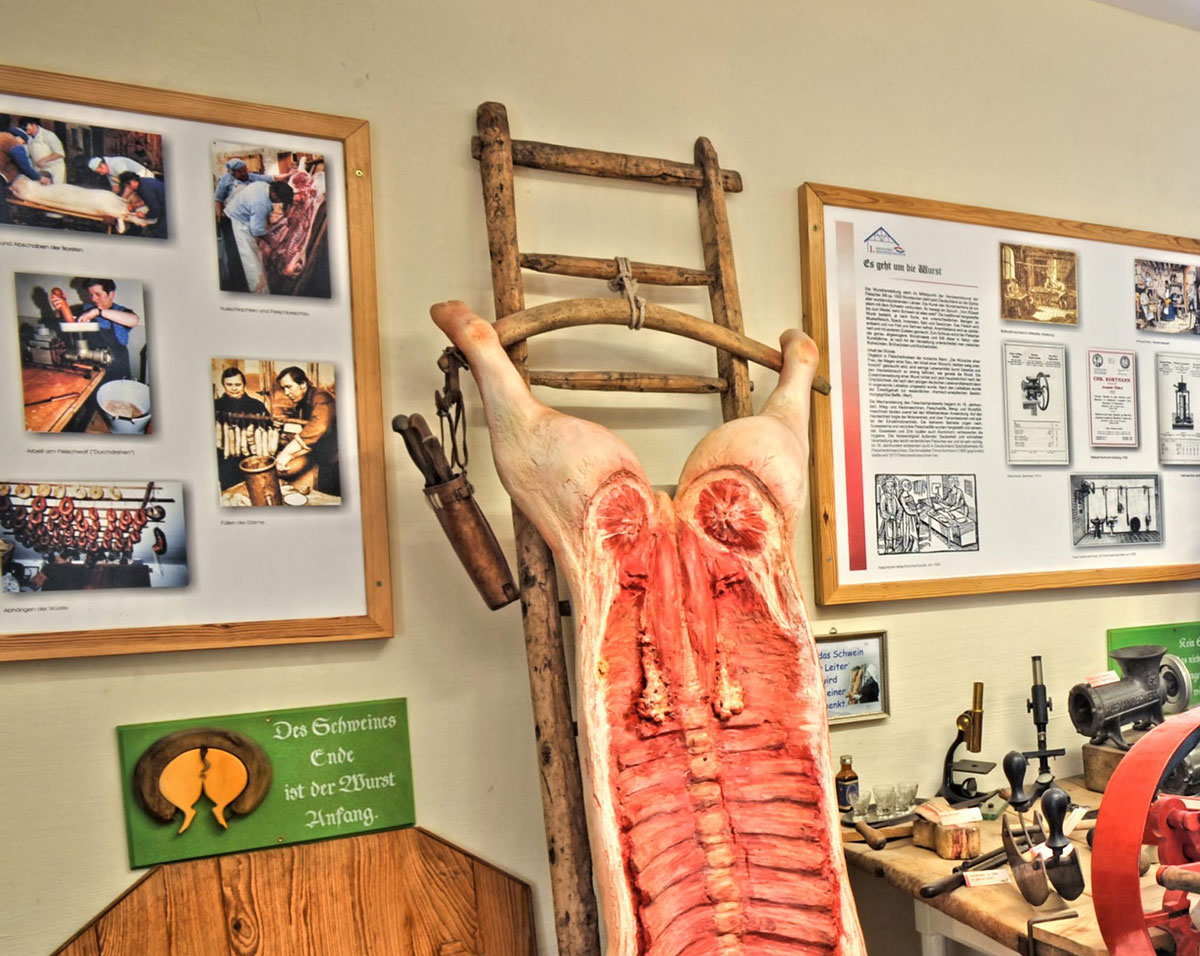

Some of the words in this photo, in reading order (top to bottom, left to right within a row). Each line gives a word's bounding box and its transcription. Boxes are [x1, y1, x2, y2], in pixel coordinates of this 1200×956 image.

[863, 259, 875, 268] Es
[876, 261, 892, 271] geht
[893, 263, 905, 272] um
[906, 263, 916, 273] die
[918, 264, 942, 275] Wurst
[833, 648, 864, 659] Schwein
[273, 721, 308, 741] Des
[312, 713, 397, 737] Schweines
[311, 748, 355, 768] Ende
[284, 783, 305, 802] ist
[310, 779, 336, 797] der
[338, 772, 396, 794] Wurst
[305, 807, 379, 829] Anfang.
